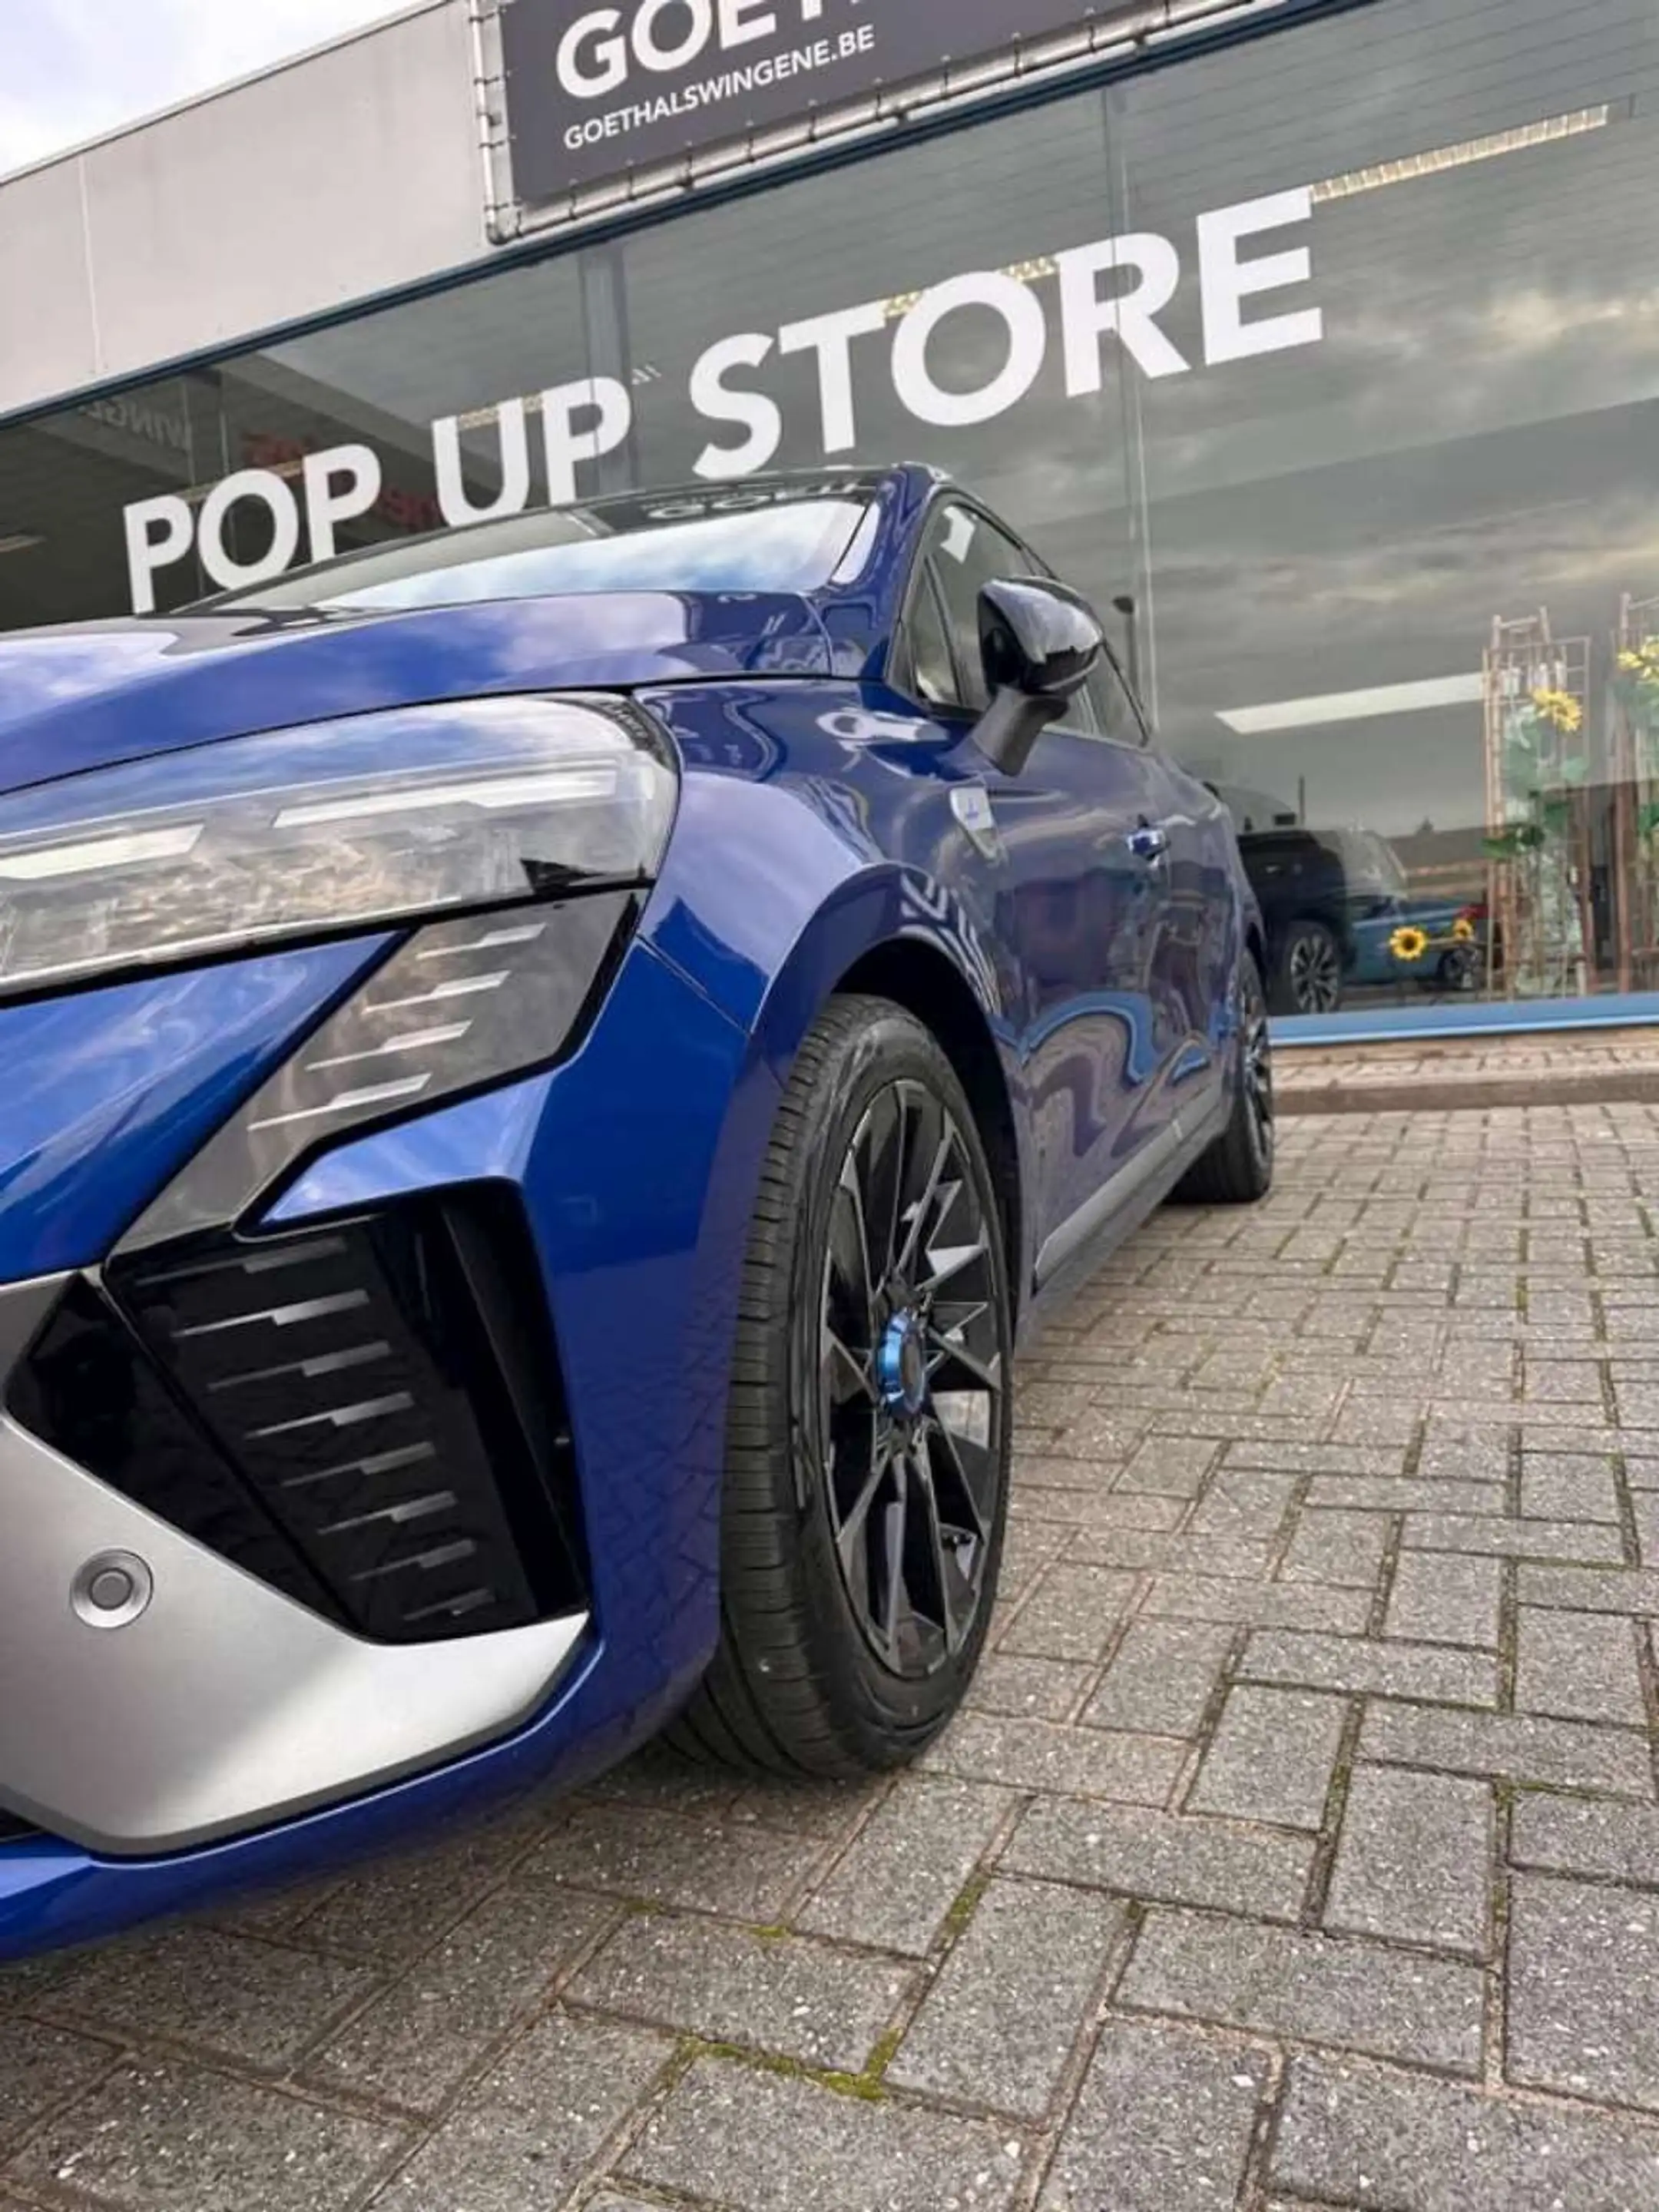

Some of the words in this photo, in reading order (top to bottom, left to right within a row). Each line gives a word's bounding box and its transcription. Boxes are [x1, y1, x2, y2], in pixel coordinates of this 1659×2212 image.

[564, 25, 875, 150] GOETHALSWINGENE.BE
[123, 443, 382, 614] POP
[432, 376, 632, 527] UP
[688, 185, 1323, 480] STORE
